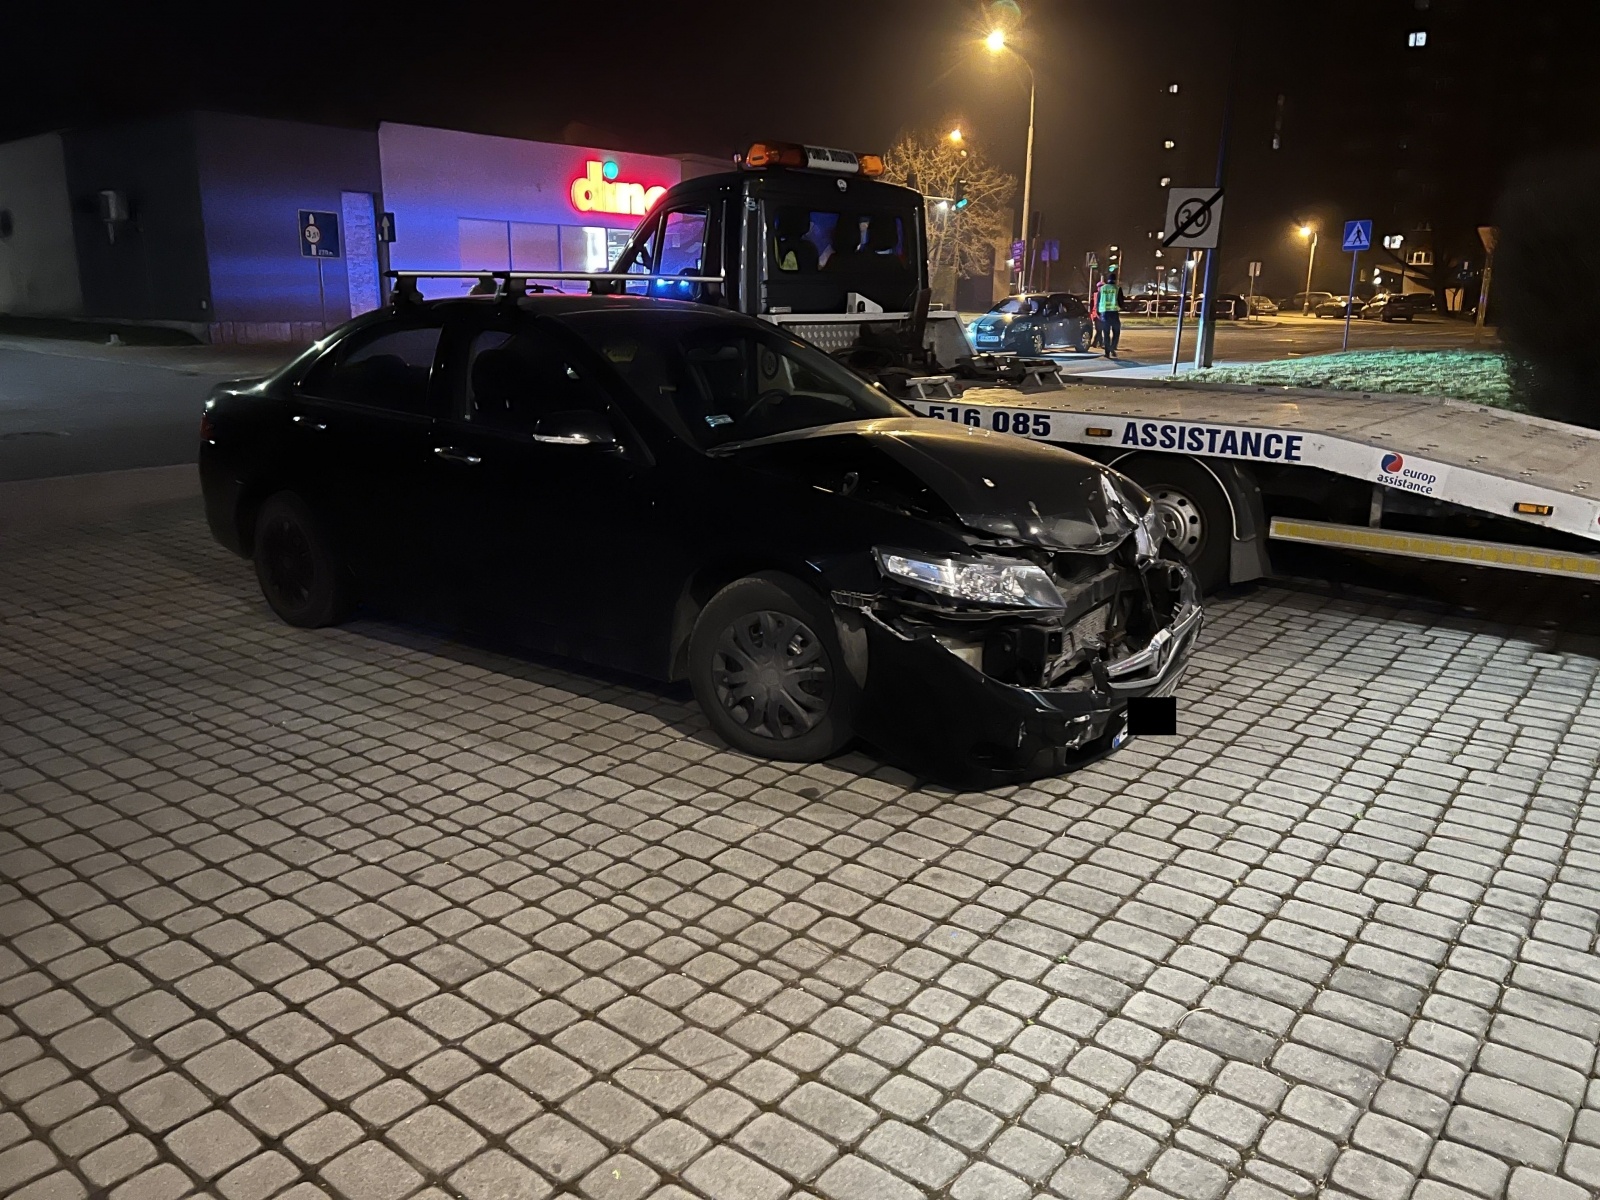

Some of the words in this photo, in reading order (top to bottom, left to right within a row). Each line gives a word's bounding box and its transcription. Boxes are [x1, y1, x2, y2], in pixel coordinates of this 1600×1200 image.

[1182, 208, 1207, 228] 30
[929, 405, 981, 428] 516
[992, 411, 1051, 437] 085
[1121, 421, 1304, 462] ASSISTANCE
[1376, 473, 1433, 495] assistance
[1402, 468, 1436, 485] europ
